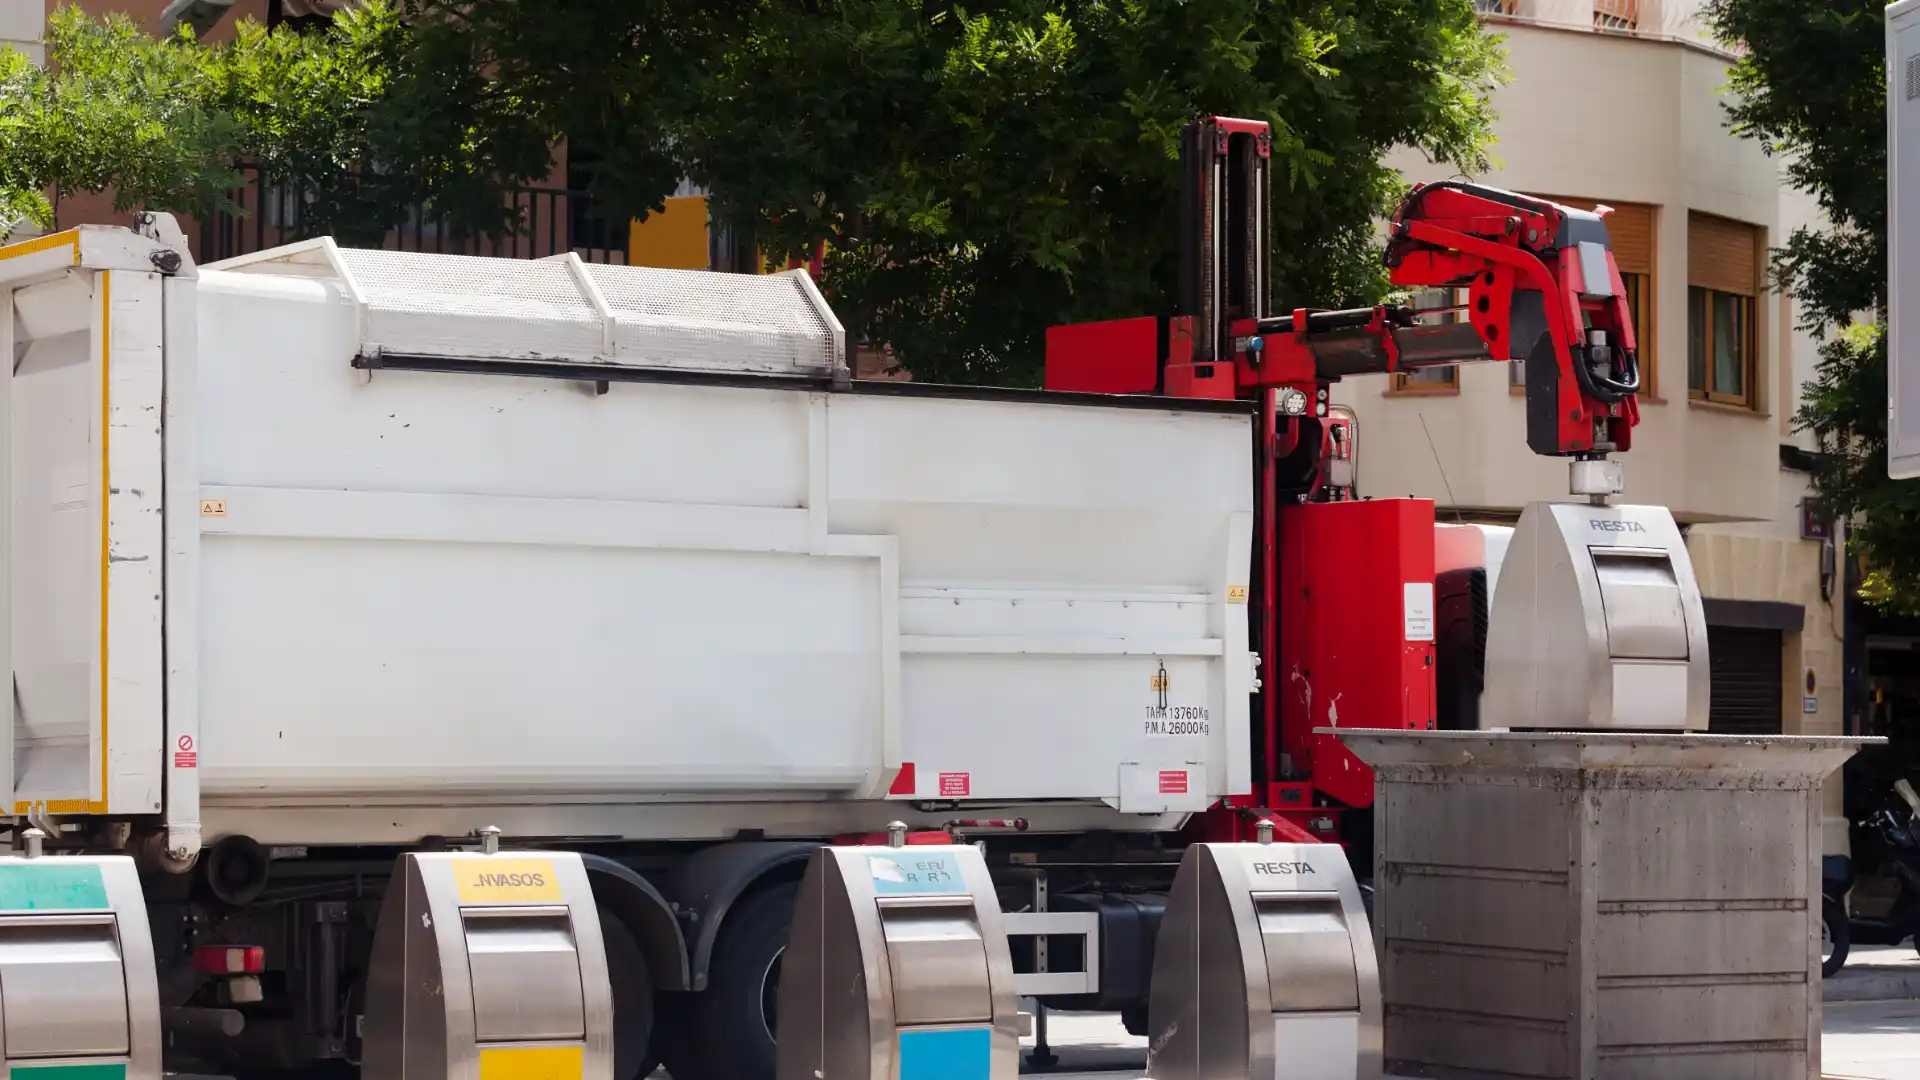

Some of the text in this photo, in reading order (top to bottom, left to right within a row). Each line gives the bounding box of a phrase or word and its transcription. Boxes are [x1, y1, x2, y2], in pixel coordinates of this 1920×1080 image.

[1589, 519, 1646, 533] RESTA
[1146, 706, 1168, 720] TARA
[1252, 862, 1316, 875] RESTA
[472, 873, 545, 887] NVASOS
